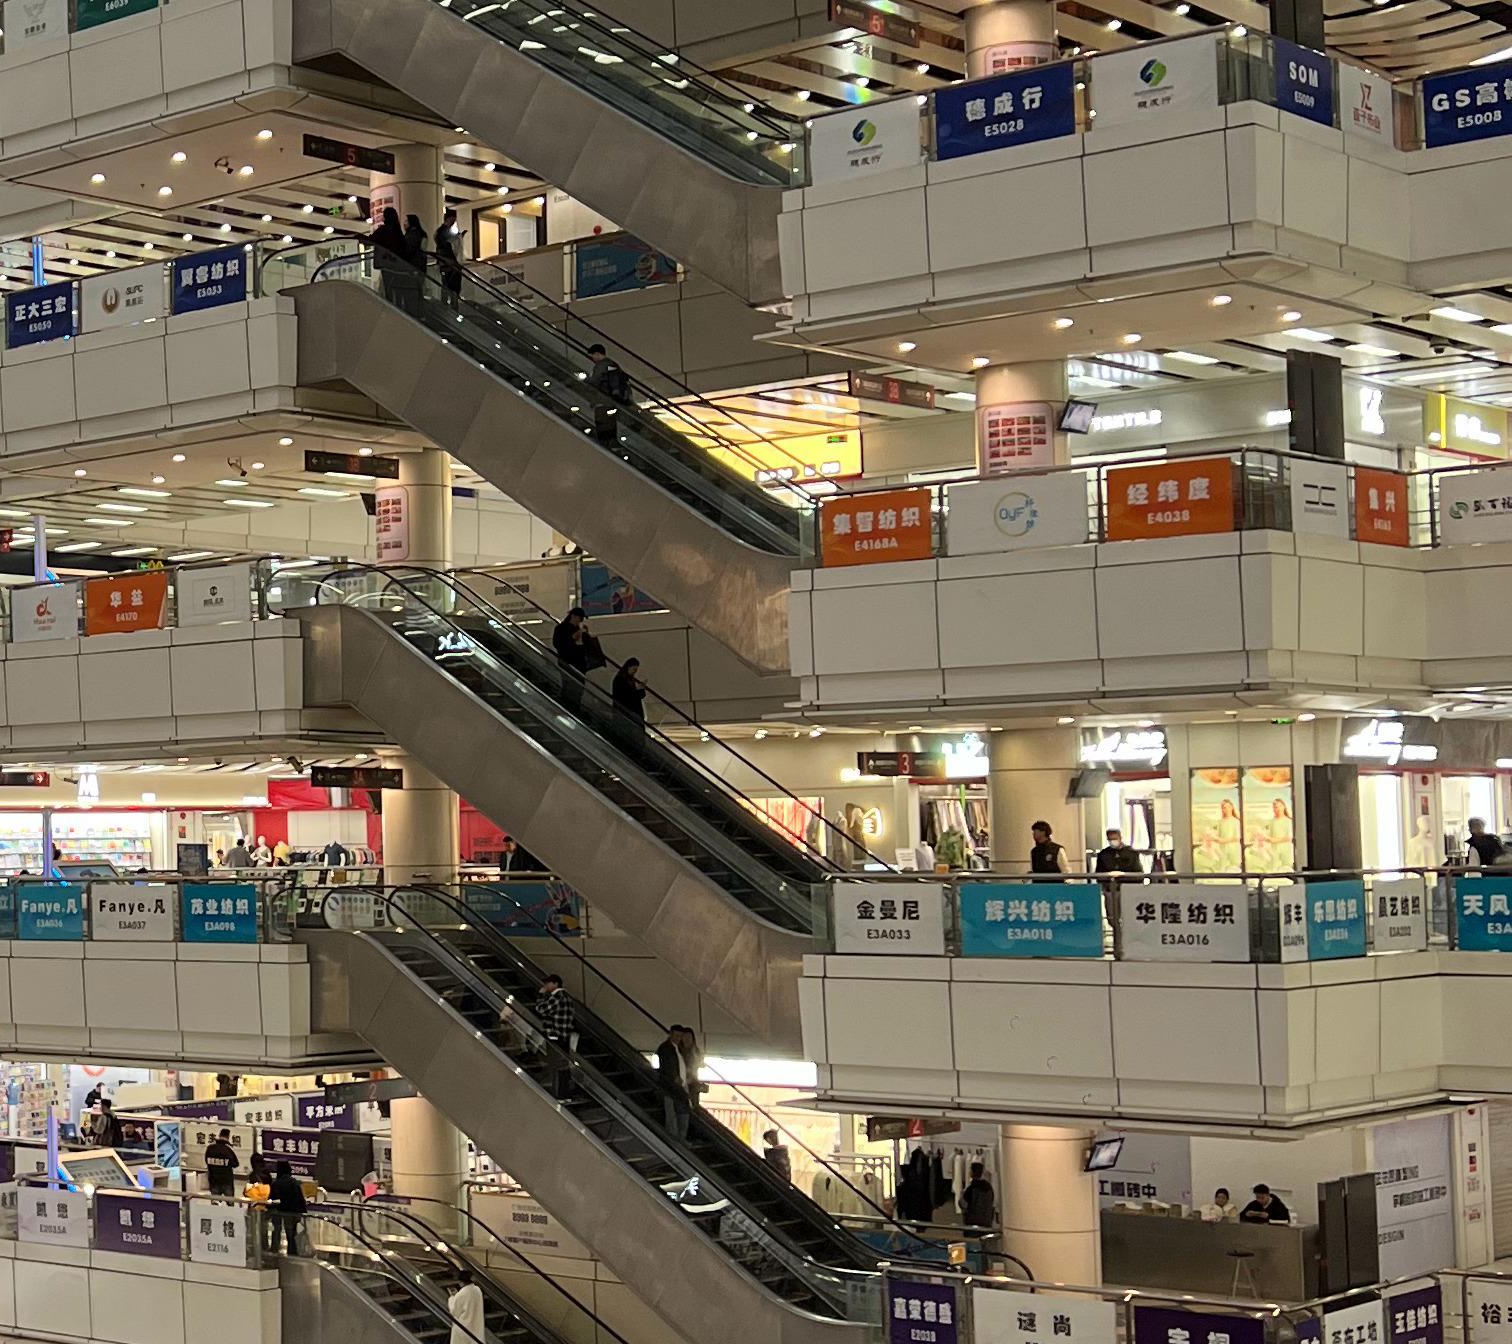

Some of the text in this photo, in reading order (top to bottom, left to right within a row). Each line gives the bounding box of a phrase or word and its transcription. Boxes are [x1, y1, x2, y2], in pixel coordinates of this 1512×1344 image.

[1288, 60, 1320, 89] SOM
[984, 119, 1024, 137] E5028
[1127, 477, 1211, 506] 经纬度
[833, 506, 921, 536] 集智纺织
[1146, 509, 1191, 525] E4038
[854, 537, 899, 552] E4168A
[98, 897, 167, 917] Fanye.凡
[856, 900, 921, 921] 金曼尼
[985, 900, 1076, 923] 辉兴纺织
[1135, 902, 1235, 925] 华隆纺织
[867, 929, 911, 940] E3A033
[1161, 933, 1210, 946] E3A016
